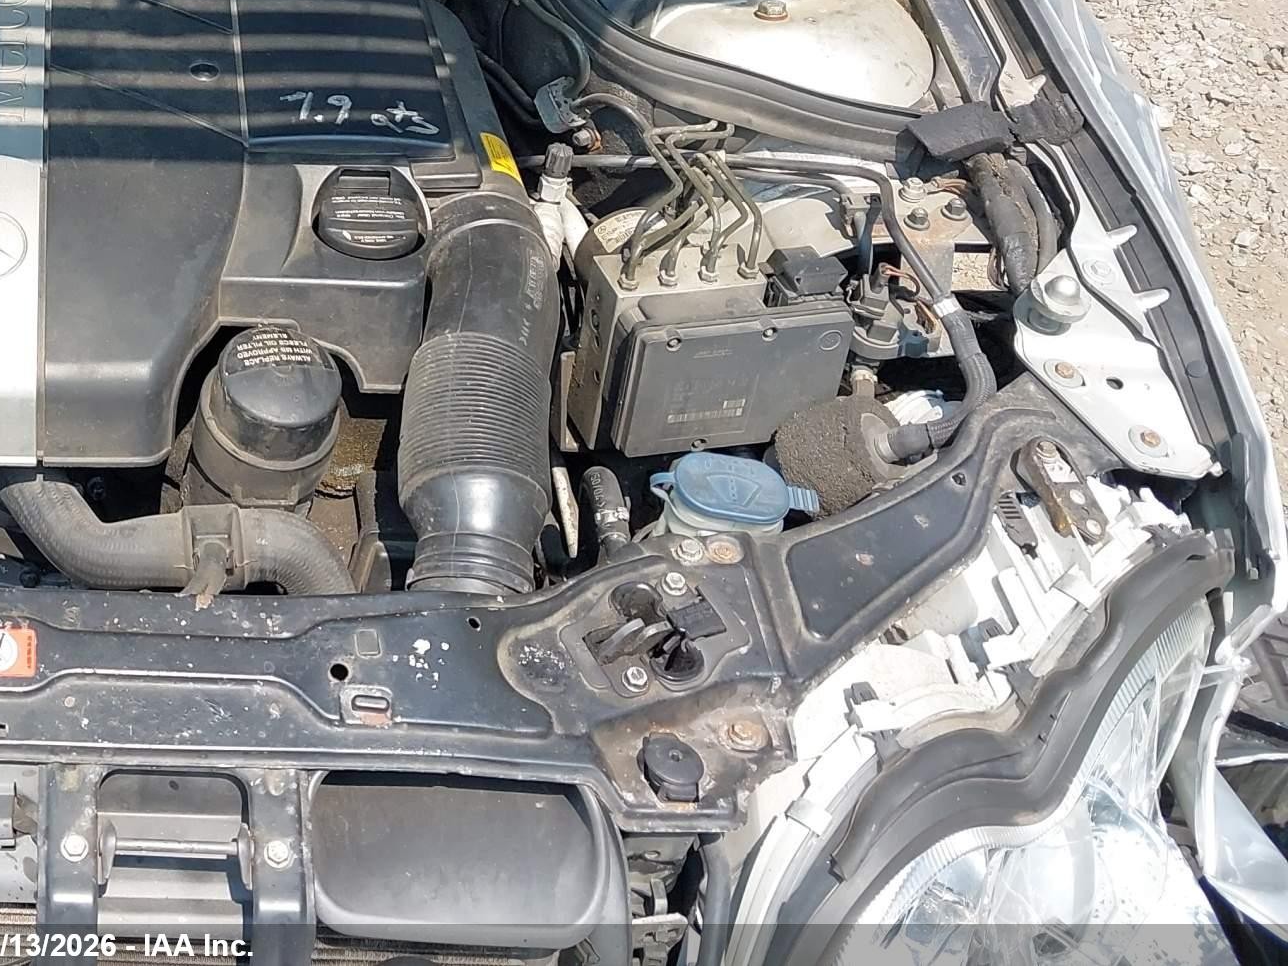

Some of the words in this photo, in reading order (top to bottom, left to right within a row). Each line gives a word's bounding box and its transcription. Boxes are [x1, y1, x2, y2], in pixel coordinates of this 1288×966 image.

[236, 341, 263, 351] FILTER
[237, 347, 278, 359] APPROVED
[280, 354, 312, 362] ALWAYS
[243, 354, 280, 366] REPLACE
